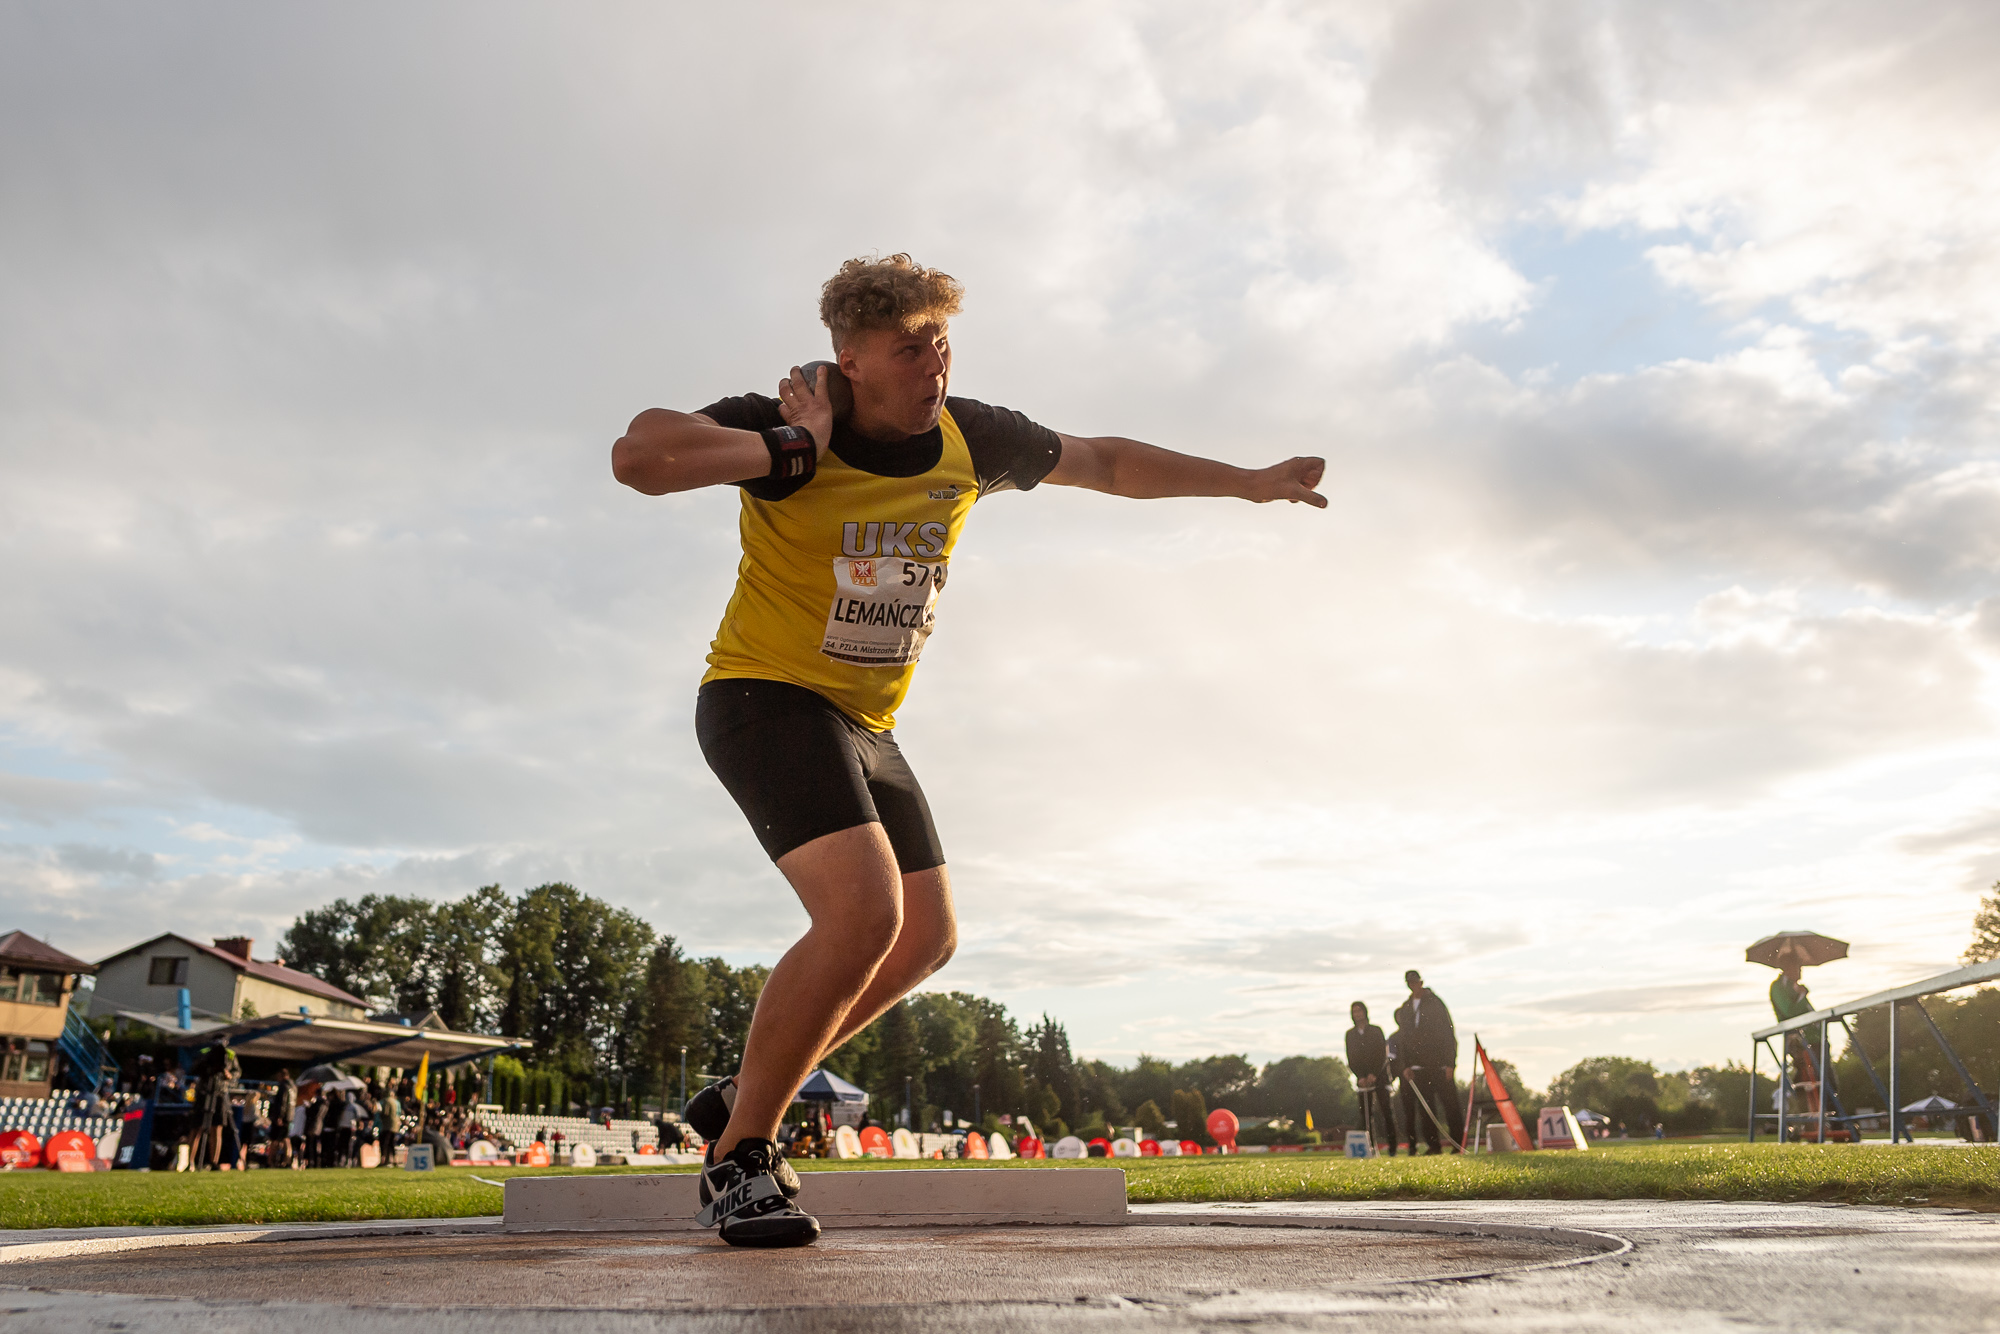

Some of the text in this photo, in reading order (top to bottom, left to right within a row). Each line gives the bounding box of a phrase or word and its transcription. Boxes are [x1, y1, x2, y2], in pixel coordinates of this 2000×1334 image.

[841, 521, 948, 558] UKS
[902, 562, 942, 586] 574
[833, 597, 934, 629] LEMAŃCZ
[825, 641, 836, 649] 54.
[839, 643, 858, 652] PZLA
[1543, 1116, 1567, 1136] 11
[1349, 1142, 1367, 1158] 15
[412, 1156, 428, 1170] 15
[711, 1182, 753, 1222] NIKE
